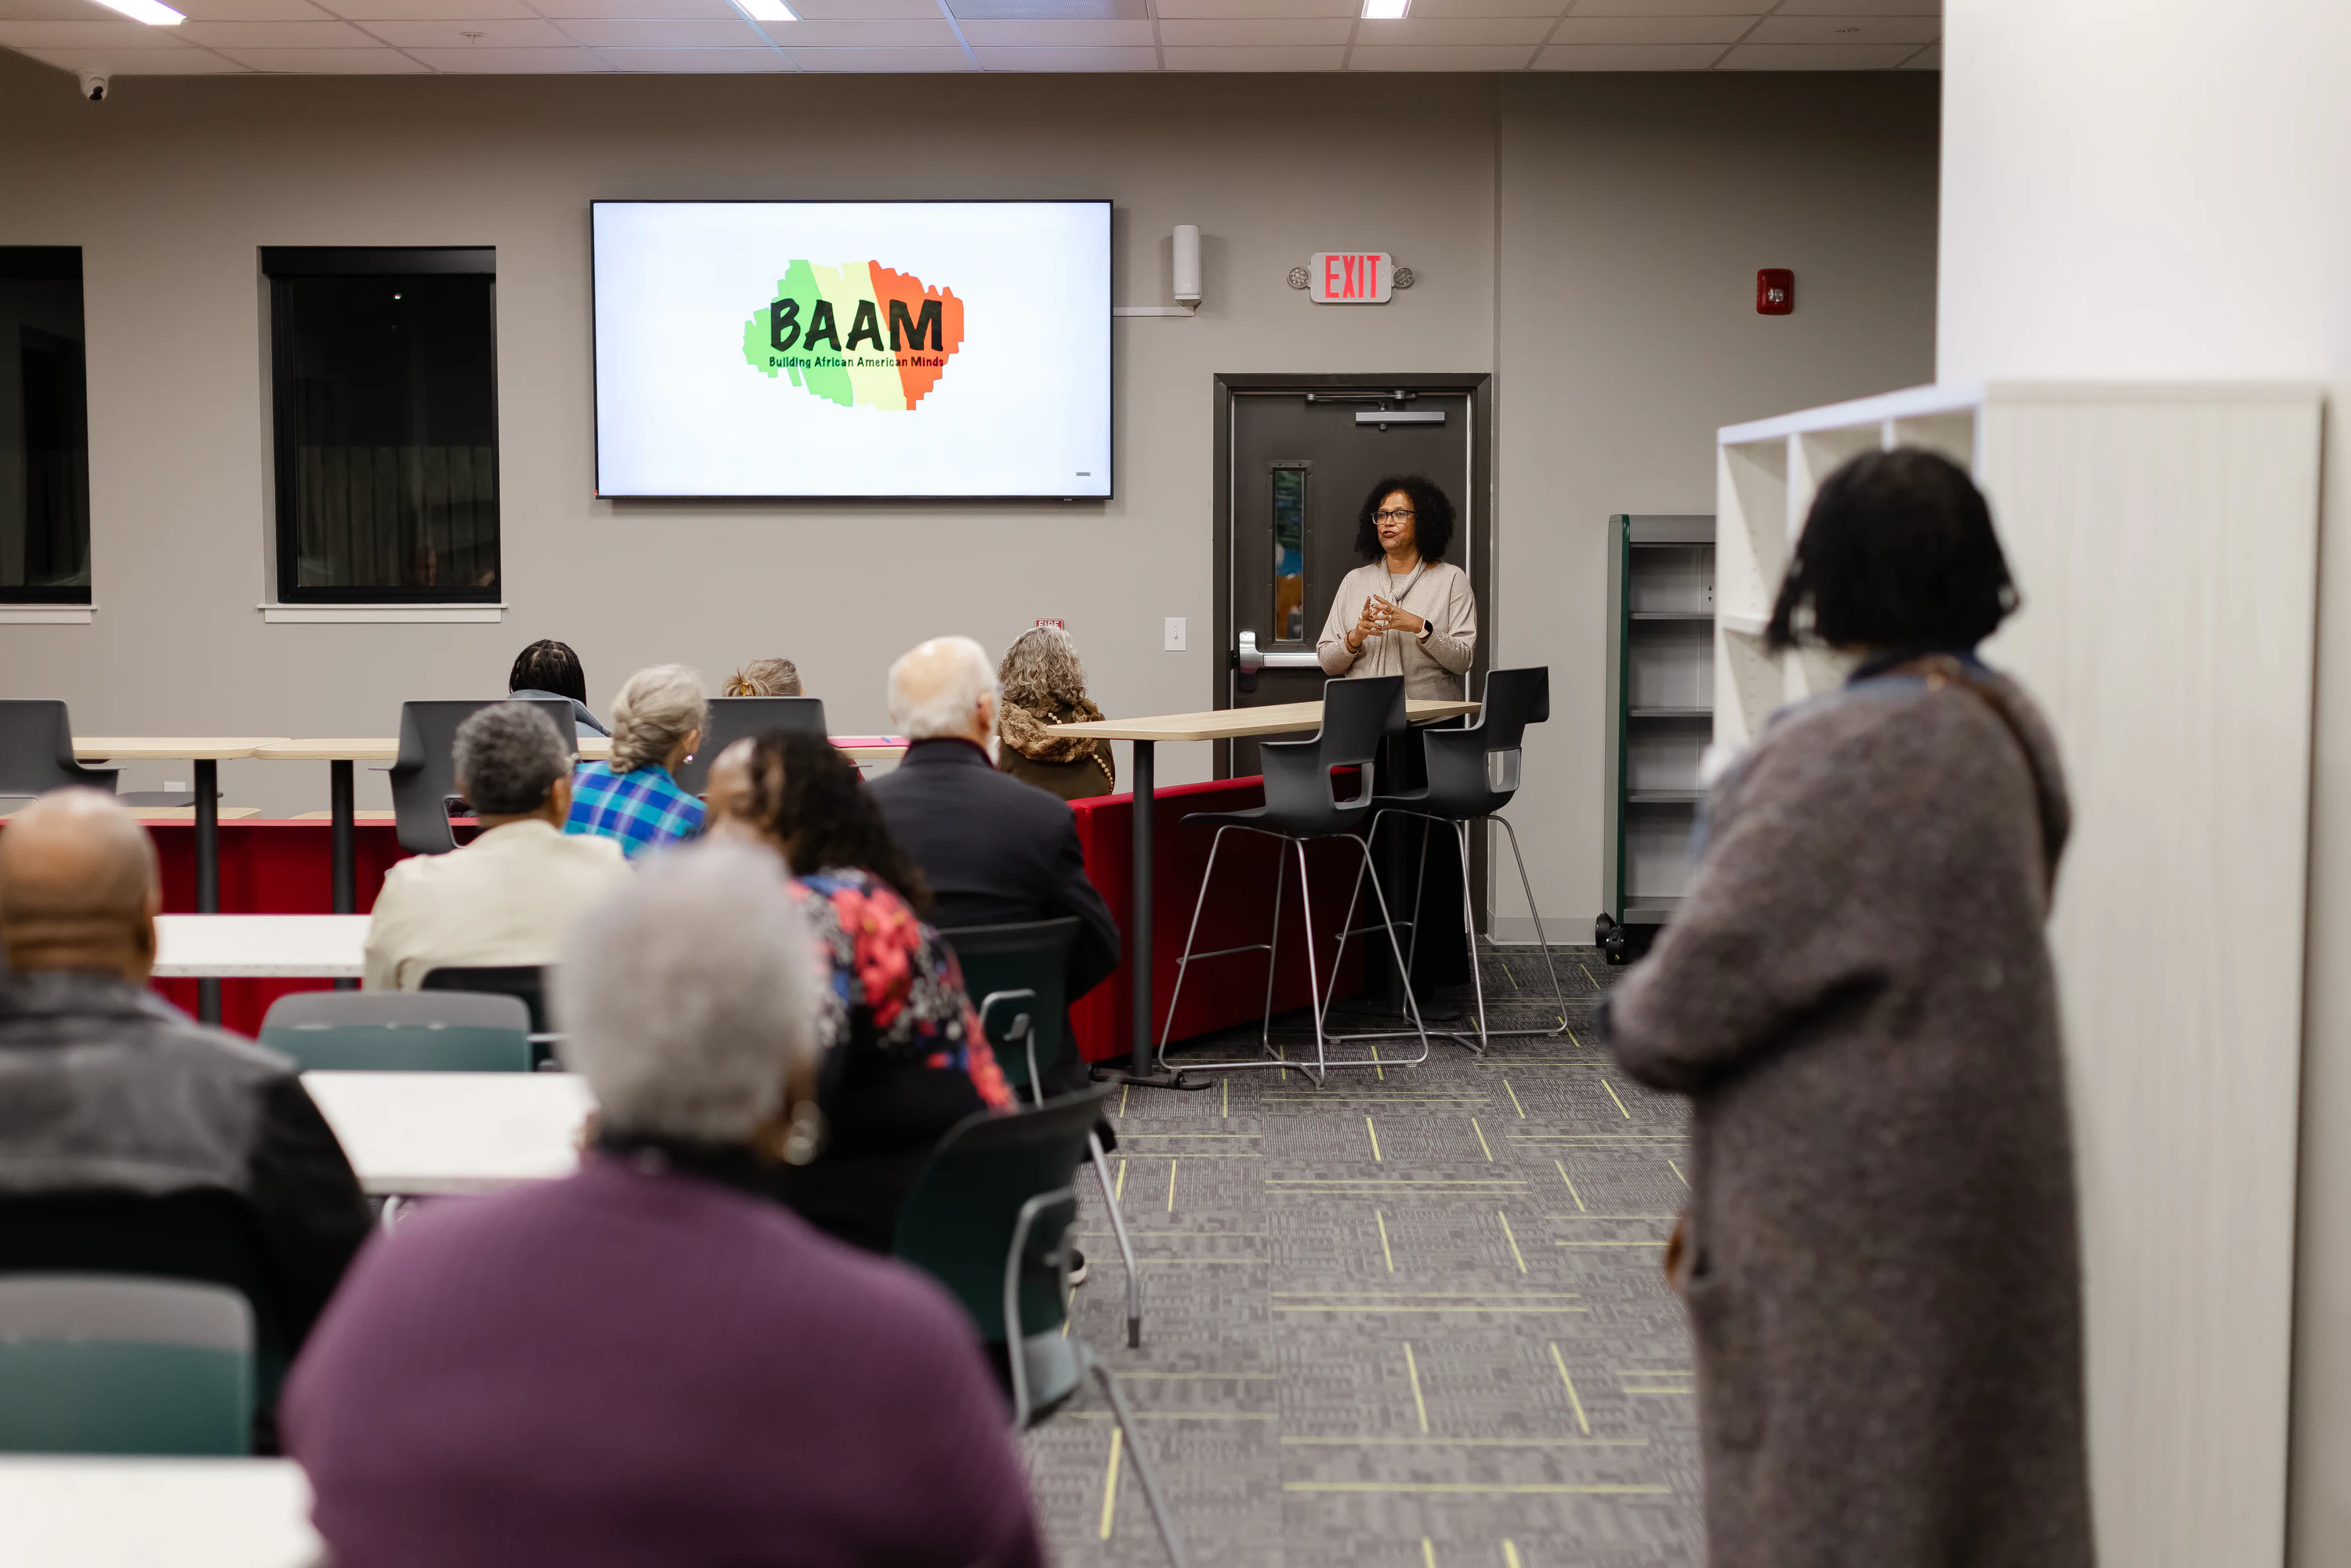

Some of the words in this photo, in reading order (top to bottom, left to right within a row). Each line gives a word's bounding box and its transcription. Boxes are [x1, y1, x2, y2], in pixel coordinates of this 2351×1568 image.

[1325, 255, 1381, 298] EXIT
[770, 299, 944, 352] BAAM
[770, 357, 811, 368] Building
[814, 357, 854, 367] African
[857, 357, 907, 367] American
[911, 357, 944, 367] Minds
